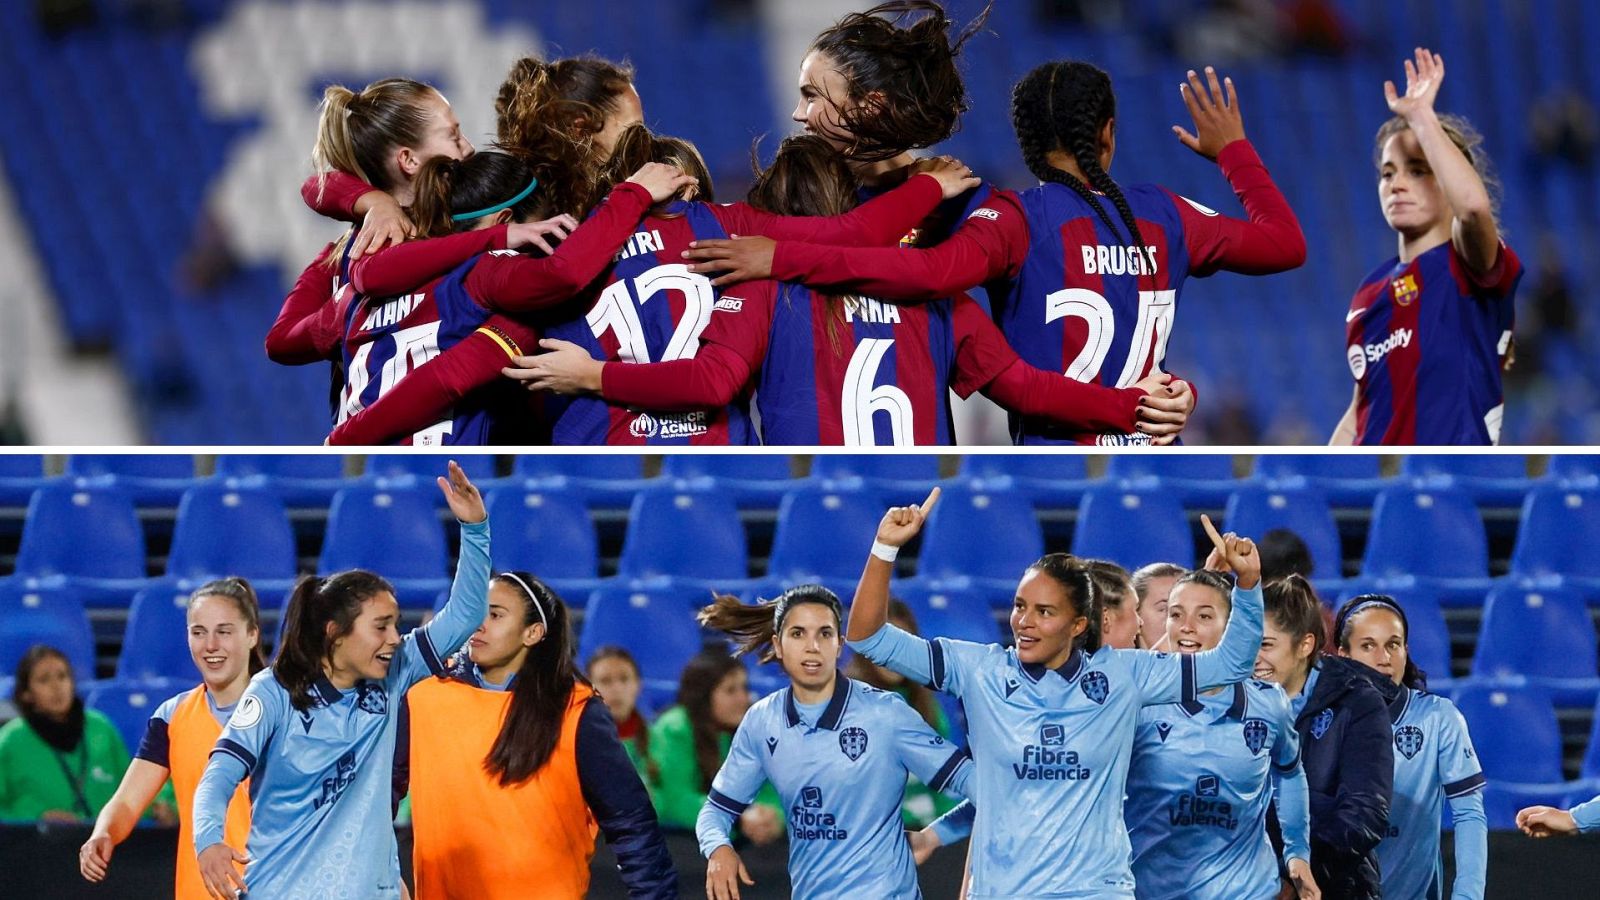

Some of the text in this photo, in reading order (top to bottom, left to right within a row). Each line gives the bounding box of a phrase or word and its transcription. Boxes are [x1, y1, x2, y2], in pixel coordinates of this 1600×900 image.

[1081, 245, 1158, 275] BRUGTS
[585, 264, 714, 364] 12
[1046, 288, 1176, 389] 24
[1365, 328, 1413, 362] Spotify
[841, 338, 915, 446] 6
[1013, 763, 1091, 780] Valencia
[790, 820, 848, 841] Valencia
[1169, 805, 1238, 831] Valencia
